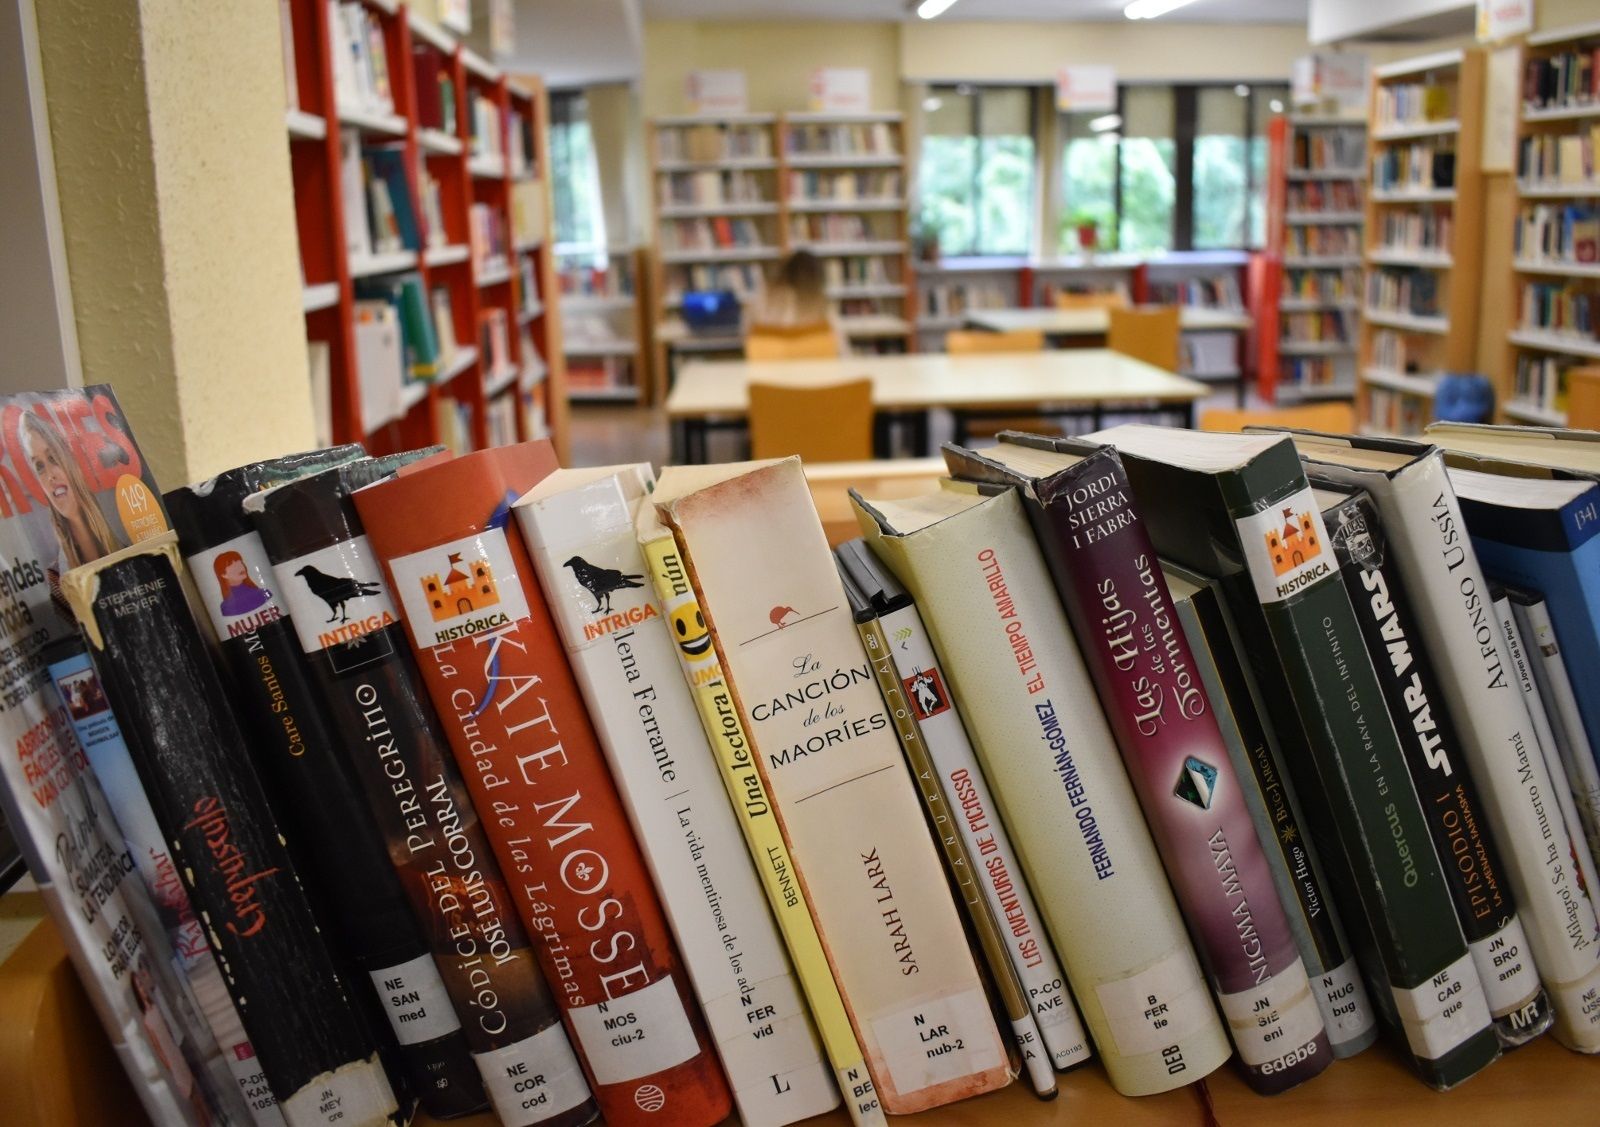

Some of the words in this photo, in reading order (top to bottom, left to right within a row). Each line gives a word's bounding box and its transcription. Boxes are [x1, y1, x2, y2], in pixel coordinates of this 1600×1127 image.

[122, 483, 148, 514] 149
[1065, 472, 1119, 512] JORDI
[1068, 491, 1128, 530] SIERRA
[1072, 535, 1081, 550] I
[1085, 508, 1138, 545] FABRA
[1431, 493, 1465, 575] USSÍA
[977, 548, 1018, 620] AMARILLO
[1276, 562, 1330, 598] HISTÓRICA
[100, 578, 166, 609] STEPHENIE
[114, 595, 160, 618] MEYER
[226, 605, 283, 638] MUJER
[318, 610, 394, 650] INTRIGA
[435, 612, 510, 643] HISTÓRICA
[583, 602, 658, 641] INTRIGA
[1097, 578, 1141, 671] Hijas
[1359, 569, 1414, 678] WARS
[1459, 576, 1509, 690] ALFONSO
[1503, 619, 1514, 641] Perla
[1005, 621, 1037, 676] TIEMPO
[1134, 554, 1205, 721] Tormentas
[1141, 623, 1157, 652] las
[1322, 616, 1350, 681] INFINITO
[1510, 640, 1518, 650] la
[612, 627, 641, 684] lena
[792, 653, 822, 678] La
[1151, 654, 1166, 674] de
[1513, 649, 1521, 660] de
[258, 655, 288, 713] Santos
[1026, 671, 1045, 695] EL
[1517, 659, 1529, 683] Joven
[752, 664, 871, 722] CANCIÓN
[1347, 684, 1361, 712] DEL
[1522, 682, 1533, 693] La
[803, 708, 821, 728] de
[824, 702, 845, 719] los
[1132, 676, 1167, 737] Las
[282, 715, 305, 757] Care
[632, 685, 677, 783] Ferrante
[714, 693, 752, 771] lectora
[1356, 714, 1374, 751] RAYA
[1403, 671, 1453, 777] STAR
[769, 713, 887, 769] MAORÍES
[1035, 699, 1088, 808] FERNÁN-GÓMEZ
[356, 684, 436, 854] PEREGRINO
[1369, 753, 1382, 773] LA
[1508, 731, 1534, 785] Mamá
[743, 773, 768, 818] Una
[1375, 777, 1389, 796] EN
[1436, 793, 1450, 804] I
[472, 622, 569, 785] KATE
[533, 789, 650, 1000] MOSSE
[950, 768, 989, 833] PICASSO
[1455, 784, 1479, 840] FANTASMA
[1528, 785, 1552, 840] muerto
[426, 774, 475, 870] CORRAL
[432, 642, 458, 679] La
[451, 688, 510, 790] Ciudad
[492, 801, 519, 828] de
[507, 836, 533, 874] las
[525, 881, 586, 1006] Lágrimas
[676, 807, 691, 828] La
[686, 830, 705, 861] vida
[976, 832, 998, 856] DE
[1075, 806, 1115, 881] FERNANDO
[1384, 802, 1418, 888] Quercus
[1546, 840, 1560, 866] ha
[861, 846, 893, 903] LARK
[1208, 826, 1243, 897] MAYA
[1292, 846, 1309, 880] Hugo
[1443, 810, 1491, 919] EPISODIO
[1474, 840, 1497, 890] AMENAZA
[427, 859, 461, 915] DEL
[767, 846, 798, 907] BENNETT
[1551, 864, 1566, 886] Se
[462, 870, 496, 919] LUIS
[696, 863, 727, 931] mentirosa
[985, 857, 1031, 937] AVENTURAS
[1304, 882, 1321, 918] Victor
[1492, 890, 1503, 908] LA
[476, 917, 521, 967] JOSÉ
[722, 936, 737, 952] de
[882, 908, 919, 976] SARAH
[1018, 938, 1043, 968] LAS
[1488, 937, 1504, 953] JN
[729, 952, 743, 974] los
[1493, 945, 1518, 967] BRO
[384, 977, 405, 992] NE
[1322, 976, 1333, 988] N
[1432, 970, 1450, 988] NE
[1498, 962, 1522, 982] ame
[391, 991, 420, 1007] SAN
[741, 994, 752, 1007] N
[1029, 978, 1062, 999] P-CO
[1147, 994, 1157, 1005] B
[1327, 982, 1355, 1003] HUG
[1437, 981, 1462, 1003] CAB
[1582, 988, 1597, 1002] NE
[398, 1007, 426, 1023] med
[598, 1001, 609, 1014] N
[746, 1005, 776, 1023] FER
[1037, 995, 1064, 1014] AVE
[1144, 1003, 1169, 1020] FER
[1253, 997, 1270, 1012] JN
[1332, 1001, 1356, 1017] bug
[1442, 1000, 1463, 1019] que
[604, 1012, 638, 1031] MOS
[752, 1024, 774, 1040] vid
[913, 1013, 925, 1026] N
[1153, 1018, 1168, 1030] tie
[1258, 1010, 1280, 1028] SIE
[611, 1029, 645, 1047] ciu-2
[919, 1025, 949, 1042] LAR
[1263, 1026, 1284, 1043] eni
[927, 1039, 964, 1058] nub-2
[506, 1062, 528, 1078] NE
[847, 1068, 858, 1082] N
[320, 1088, 333, 1102] JN
[514, 1074, 546, 1094] COR
[769, 1073, 791, 1097] L
[319, 1097, 342, 1114] MEY
[522, 1093, 547, 1110] cod
[858, 1099, 879, 1115] lec
[328, 1110, 343, 1123] cre
